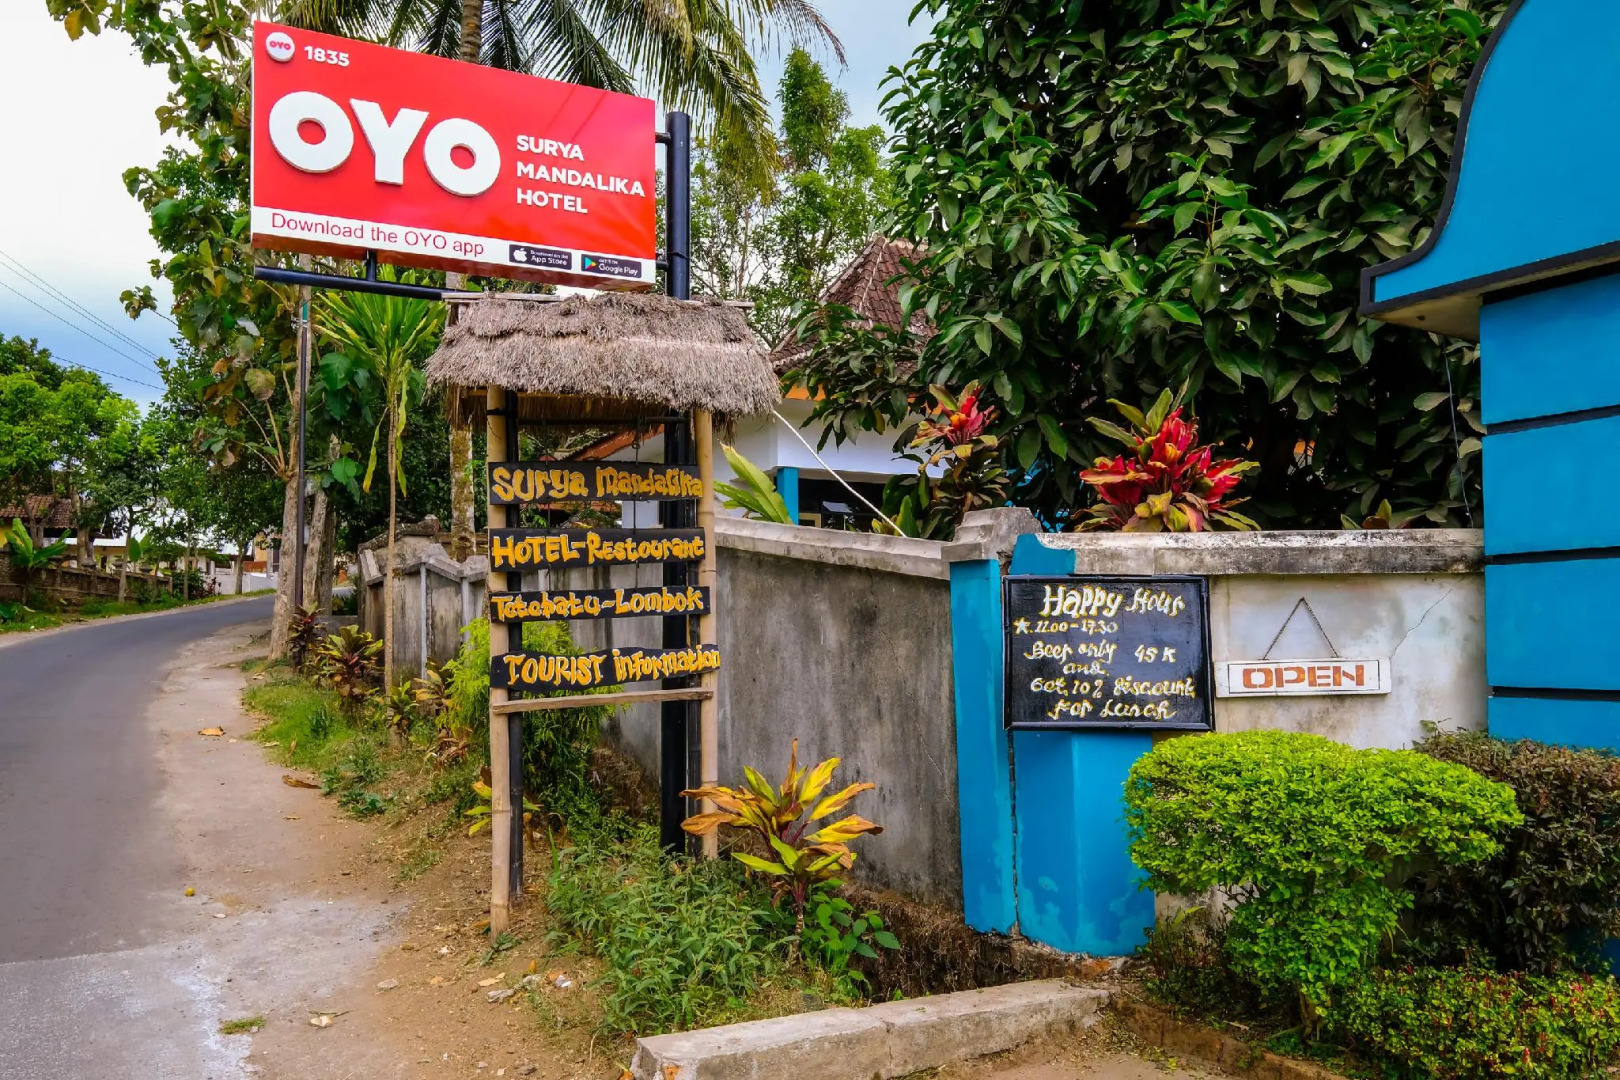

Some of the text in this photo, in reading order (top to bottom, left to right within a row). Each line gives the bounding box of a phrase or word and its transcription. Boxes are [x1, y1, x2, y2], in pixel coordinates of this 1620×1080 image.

[269, 40, 291, 51] OYO
[304, 46, 350, 67] 1835
[269, 91, 501, 198] OYO
[516, 134, 584, 162] SURYA
[516, 161, 645, 198] MANDALIKA
[516, 187, 589, 214] HOTEL
[272, 213, 484, 256] Download the OYO app
[531, 255, 568, 266] App Store
[598, 263, 638, 276] Google Play
[492, 466, 703, 501] Surya Mandalika
[1039, 584, 1185, 618] Happy Hour
[1077, 639, 1118, 664] only
[1134, 644, 1159, 663] 45
[503, 653, 607, 687] TOURIST
[1242, 664, 1365, 689] OPEN
[1099, 698, 1177, 720] Lunch
